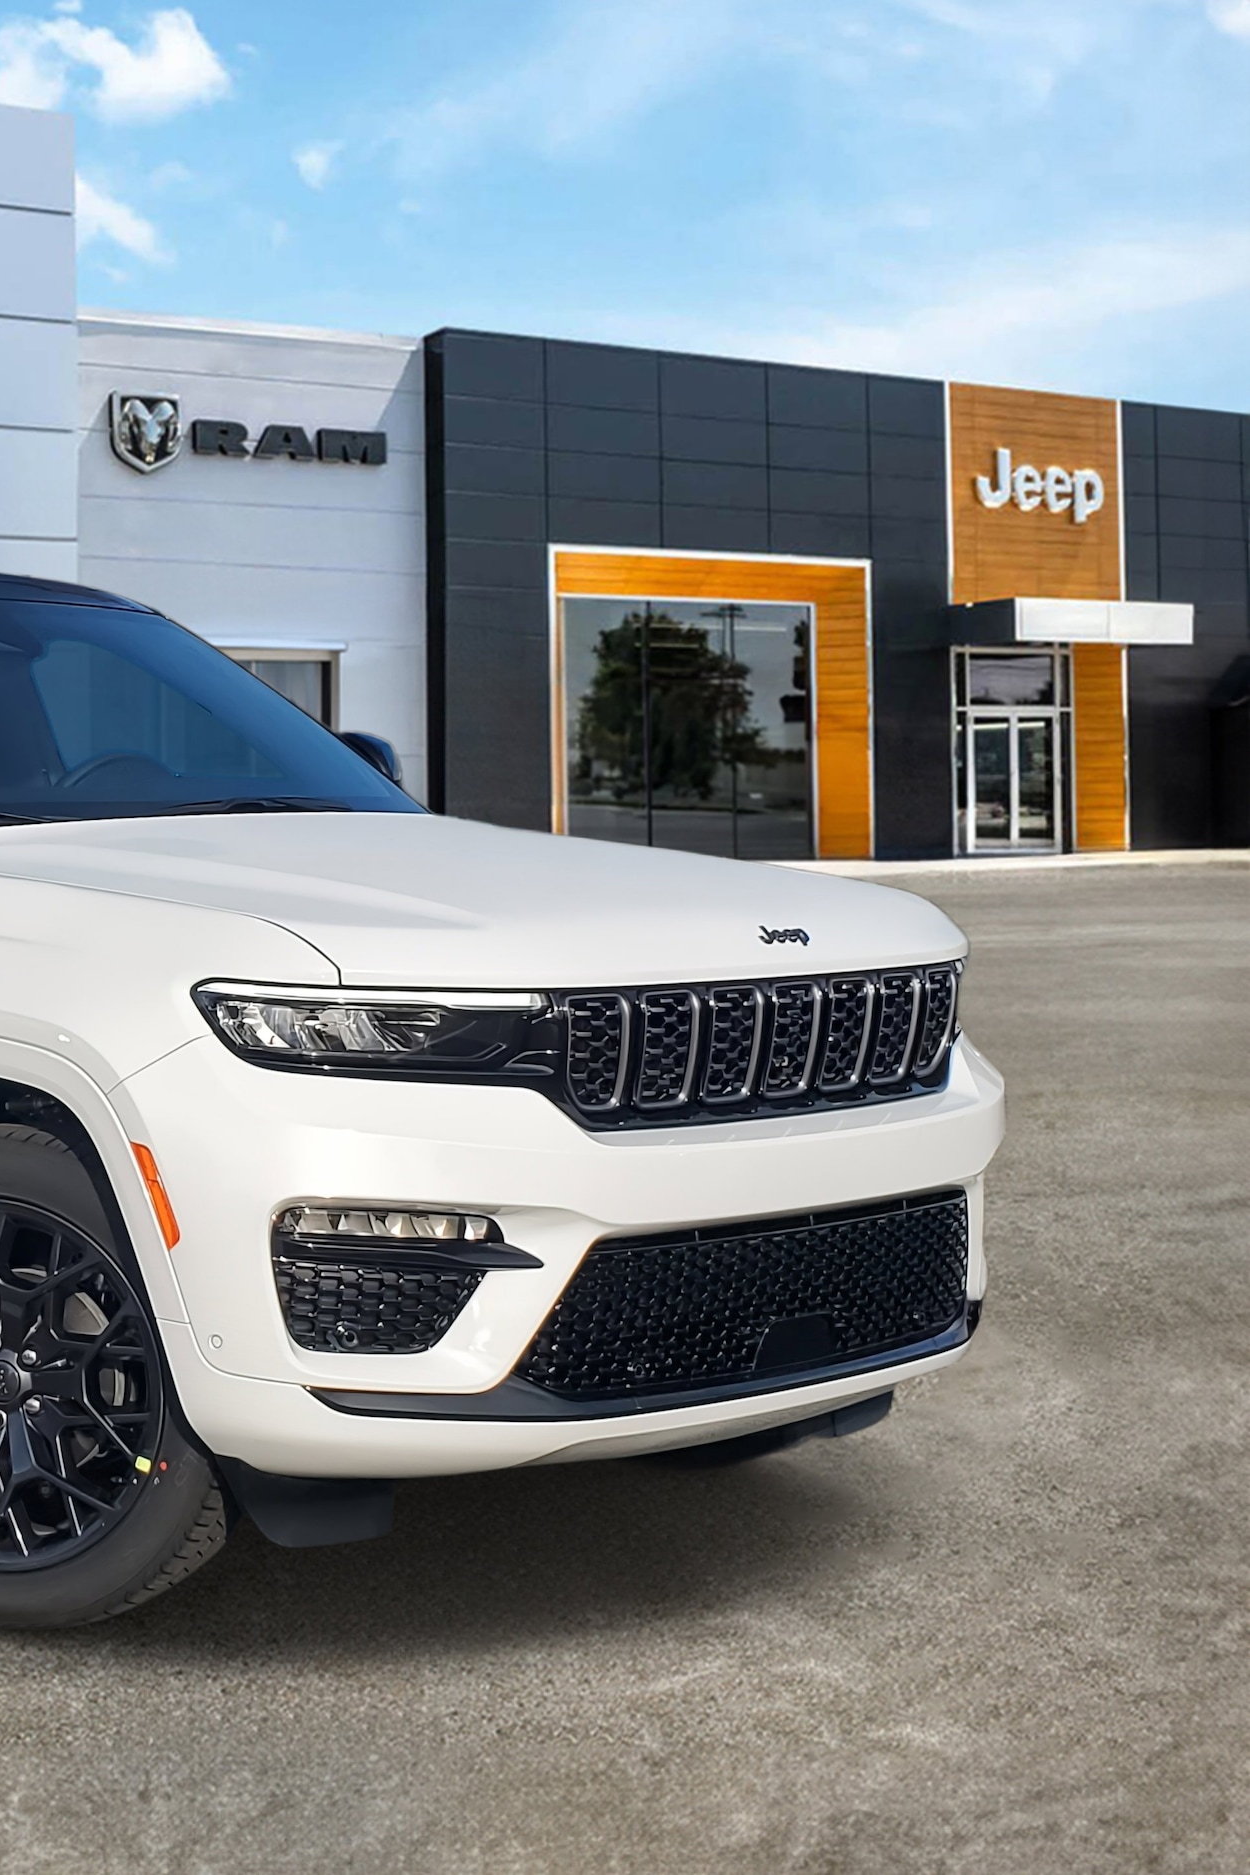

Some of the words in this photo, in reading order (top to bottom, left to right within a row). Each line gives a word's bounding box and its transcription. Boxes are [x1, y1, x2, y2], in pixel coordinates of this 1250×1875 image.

[191, 418, 388, 465] RAM
[975, 447, 1105, 523] Jeep
[758, 925, 810, 946] Jeep
